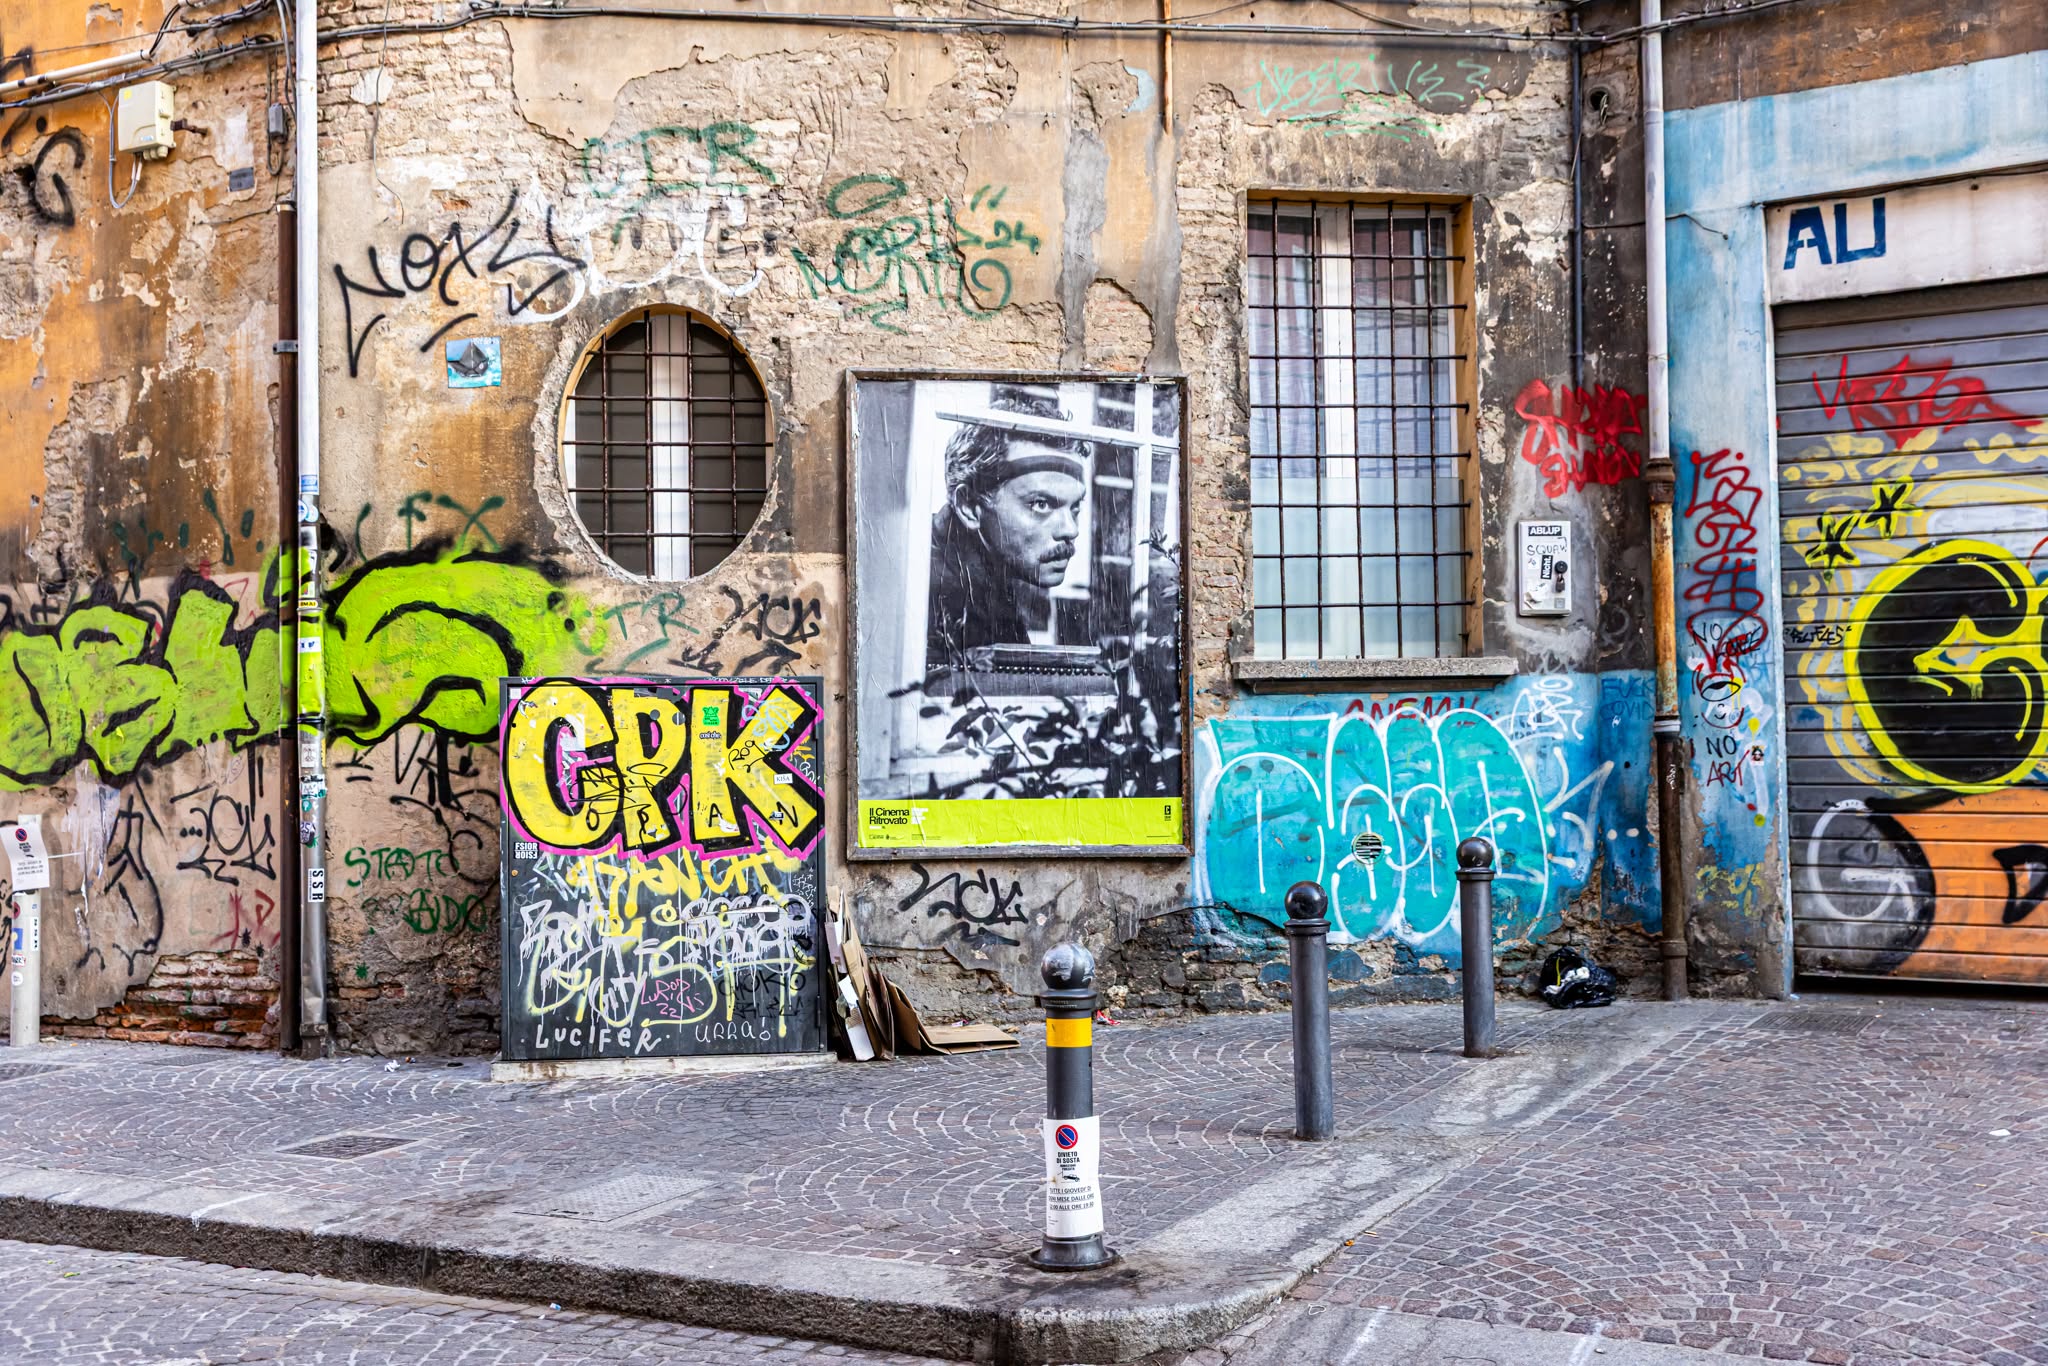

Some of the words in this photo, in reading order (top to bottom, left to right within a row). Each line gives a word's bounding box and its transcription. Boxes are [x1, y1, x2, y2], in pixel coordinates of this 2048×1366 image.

[1529, 526, 1561, 535] ABLUP
[1705, 735, 1737, 758] NO
[502, 675, 824, 858] CPK
[1706, 749, 1750, 787] ART
[869, 807, 874, 816] Il
[875, 807, 910, 816] Cinema
[869, 816, 908, 825] Ritrovato
